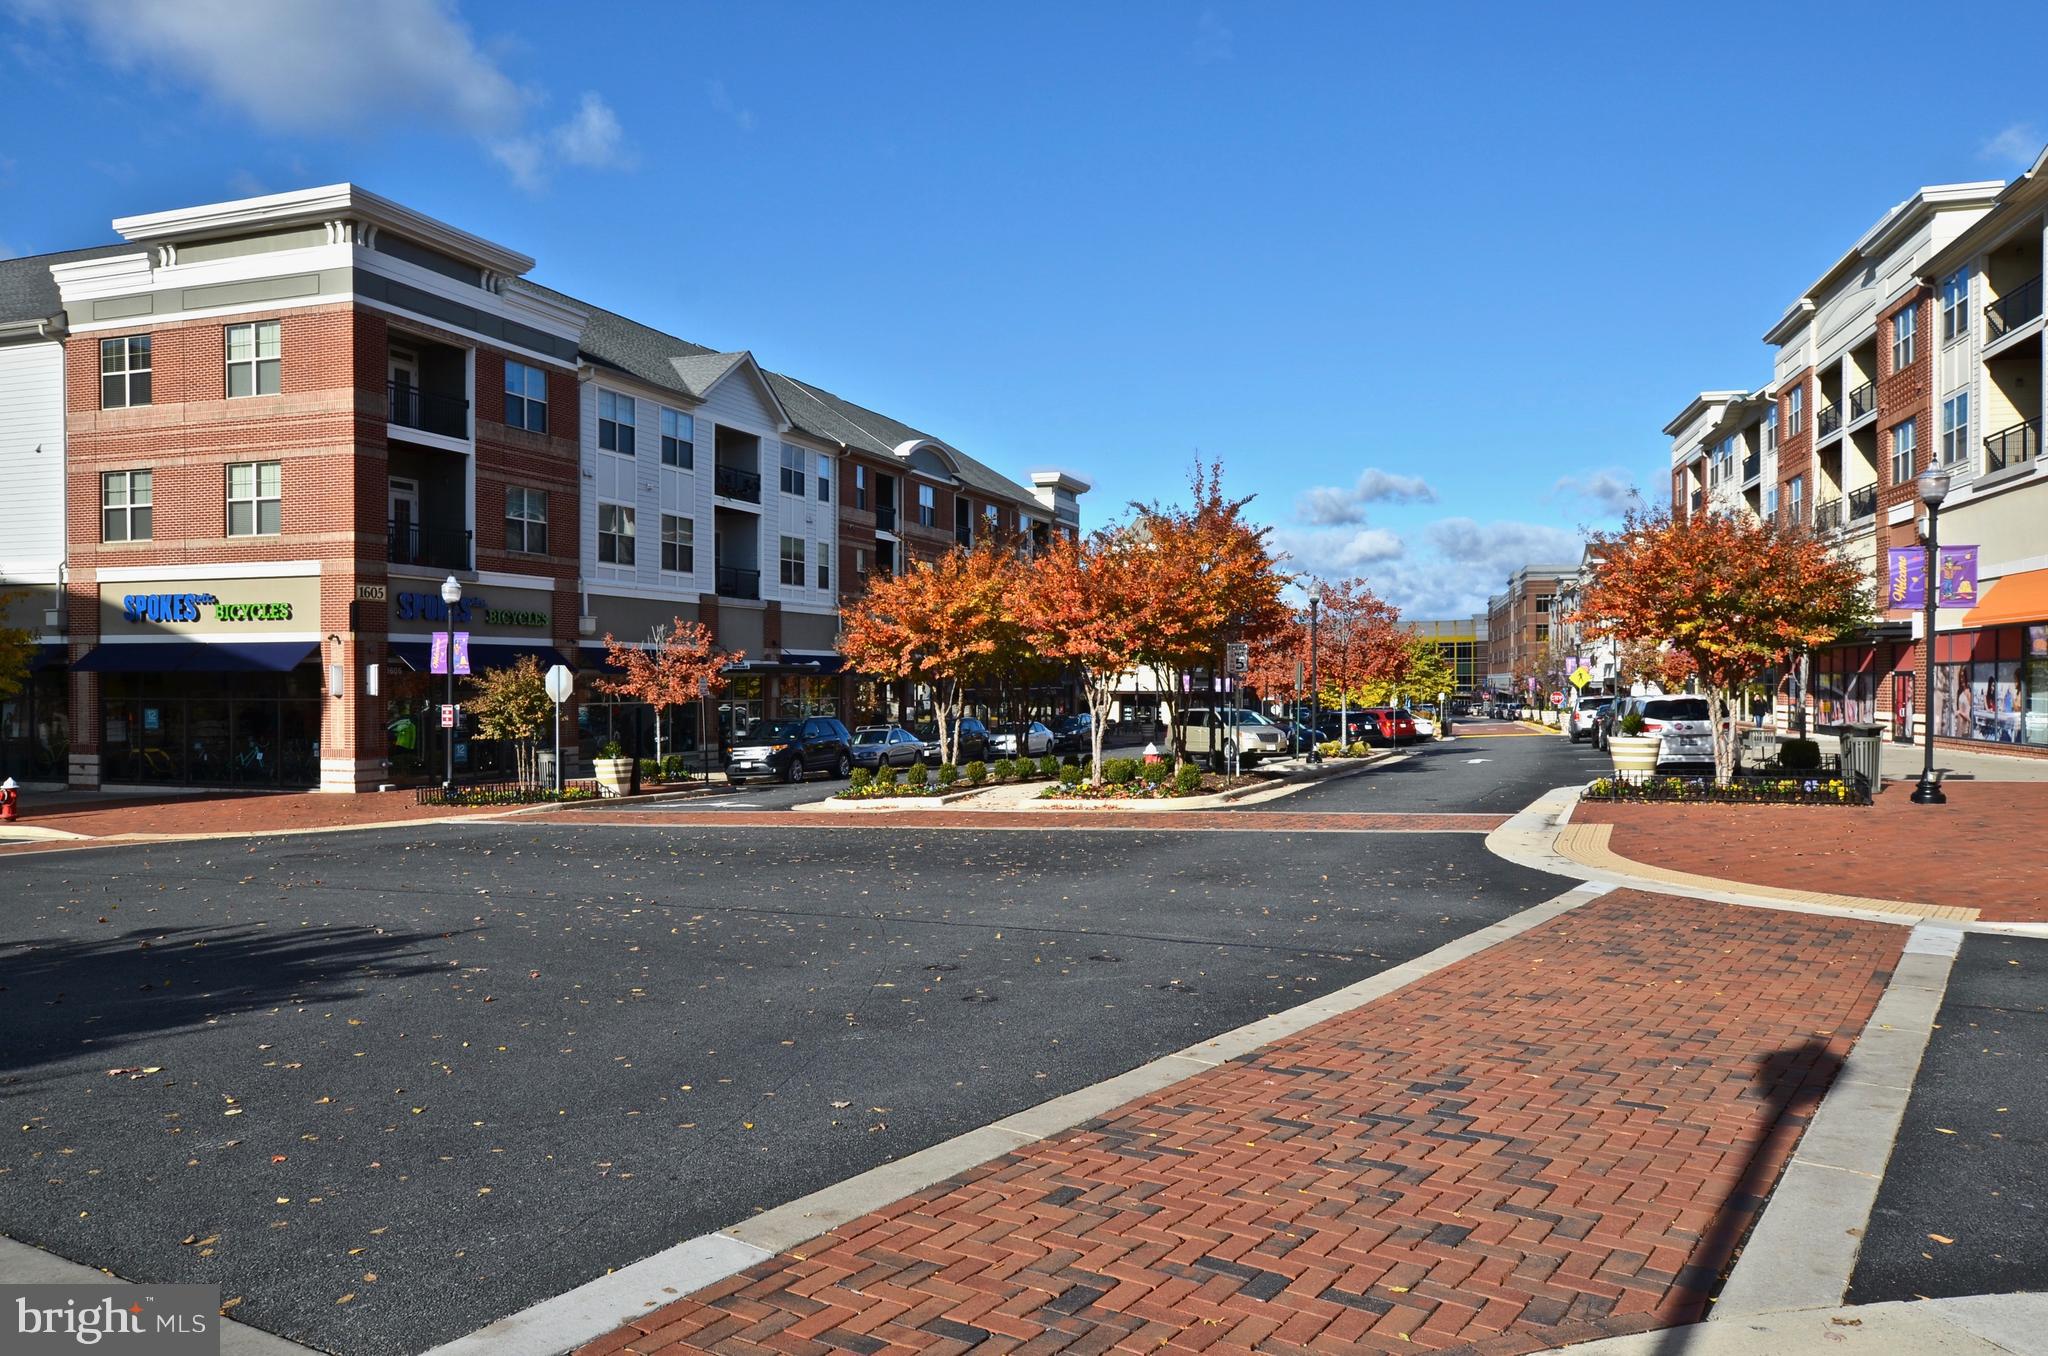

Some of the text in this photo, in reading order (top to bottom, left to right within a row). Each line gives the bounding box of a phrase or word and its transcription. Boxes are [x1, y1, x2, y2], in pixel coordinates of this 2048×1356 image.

[1892, 555, 1907, 602] Welcome
[359, 586, 384, 600] 1605
[123, 593, 198, 622] SPOKES
[215, 603, 290, 620] BICYCLES
[488, 609, 549, 626] BICYCLES
